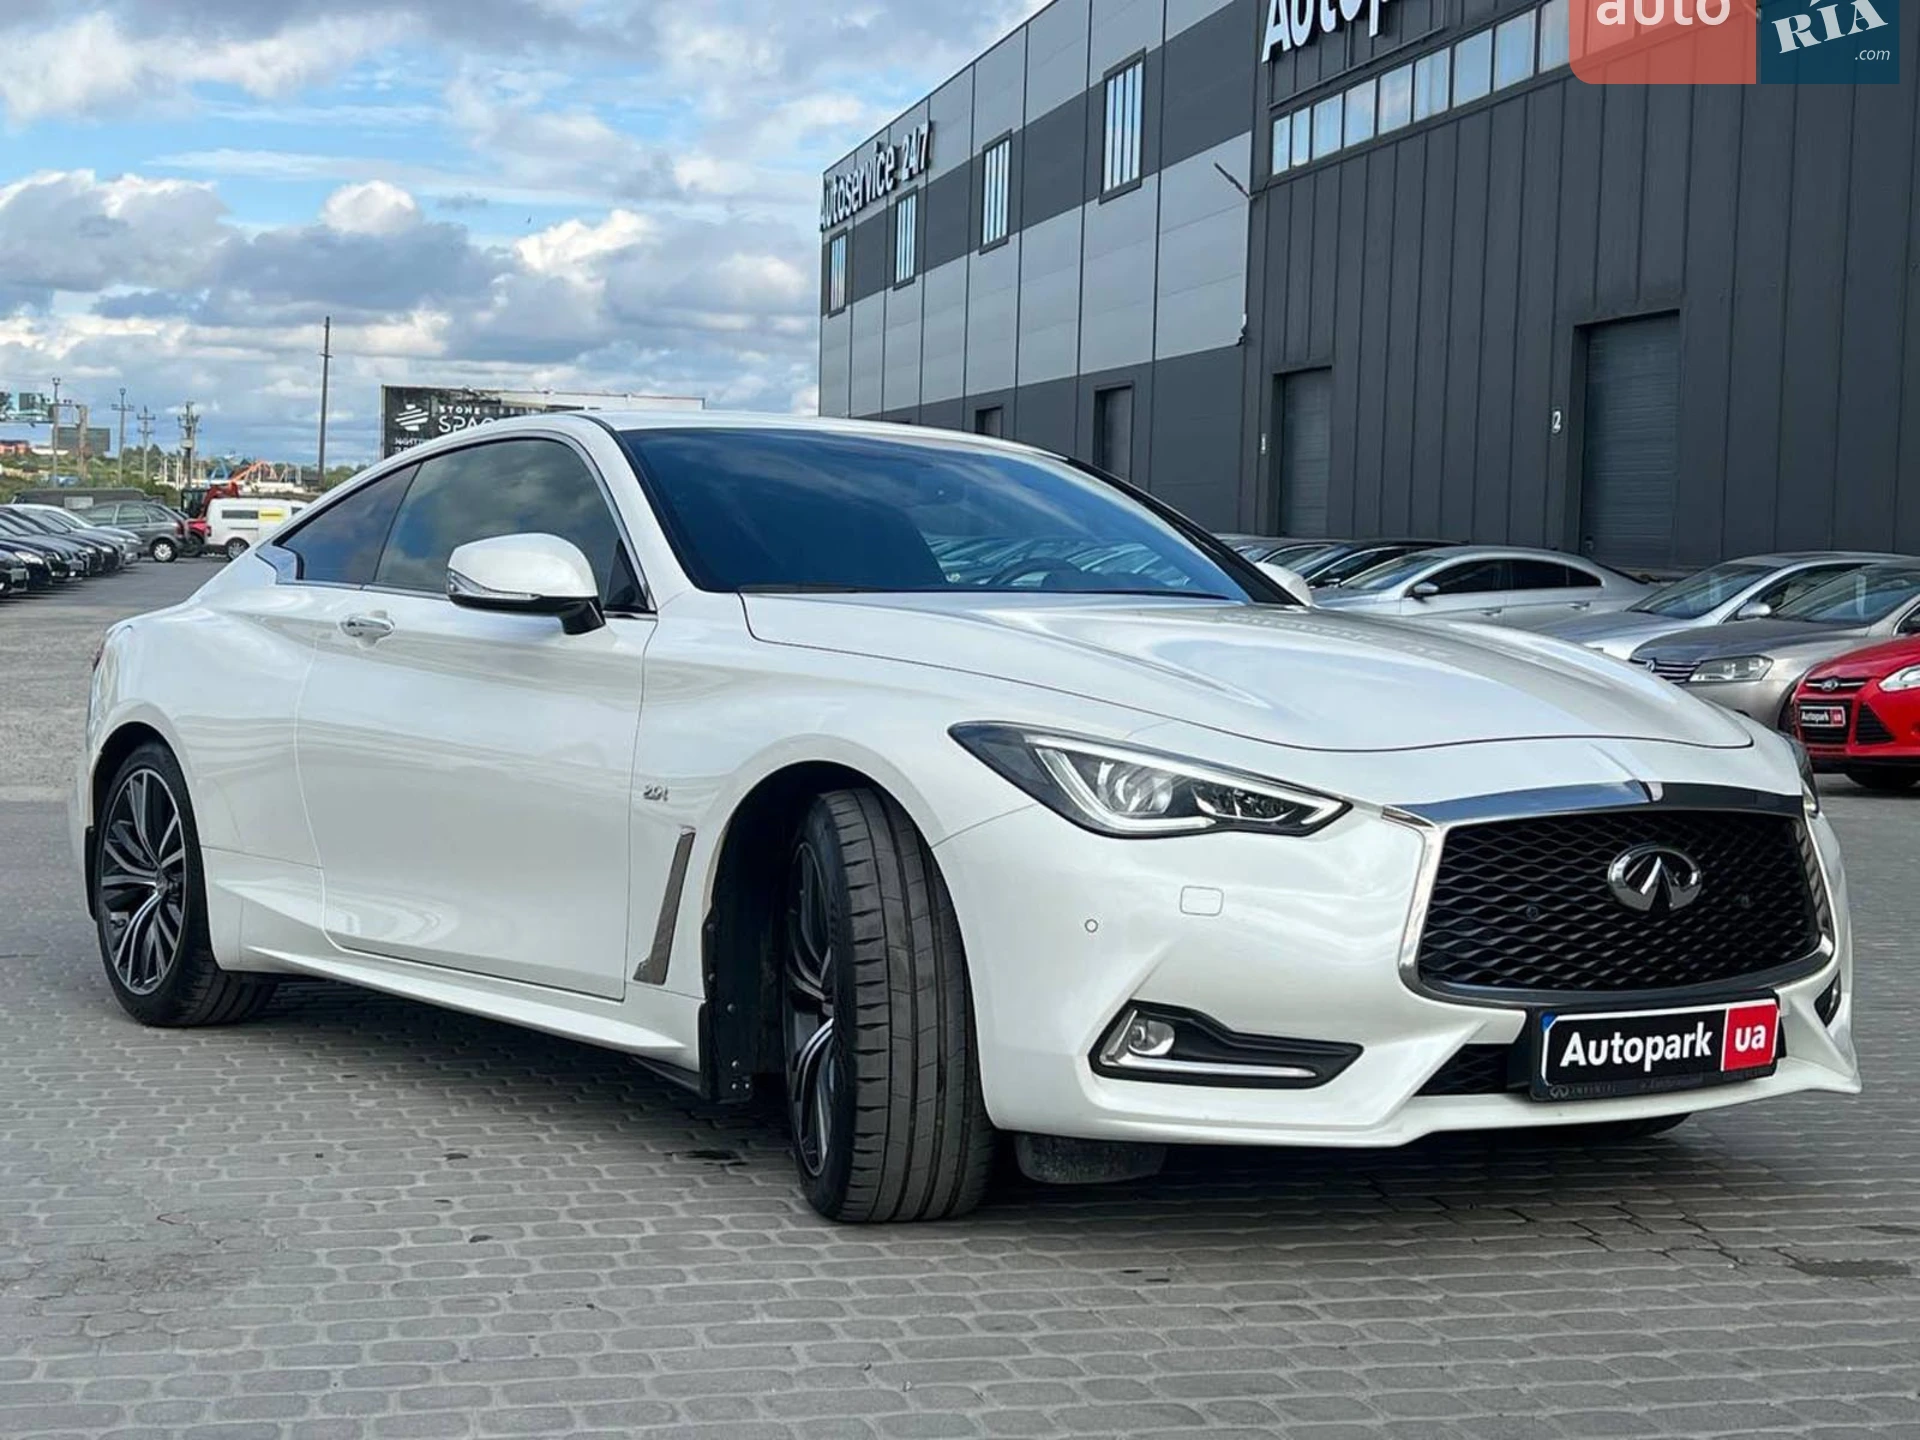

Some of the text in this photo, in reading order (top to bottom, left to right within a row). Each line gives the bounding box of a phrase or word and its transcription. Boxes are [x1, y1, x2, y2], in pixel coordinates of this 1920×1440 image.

[439, 405, 481, 414] STONE
[1559, 1021, 1766, 1072] Autopark ua
